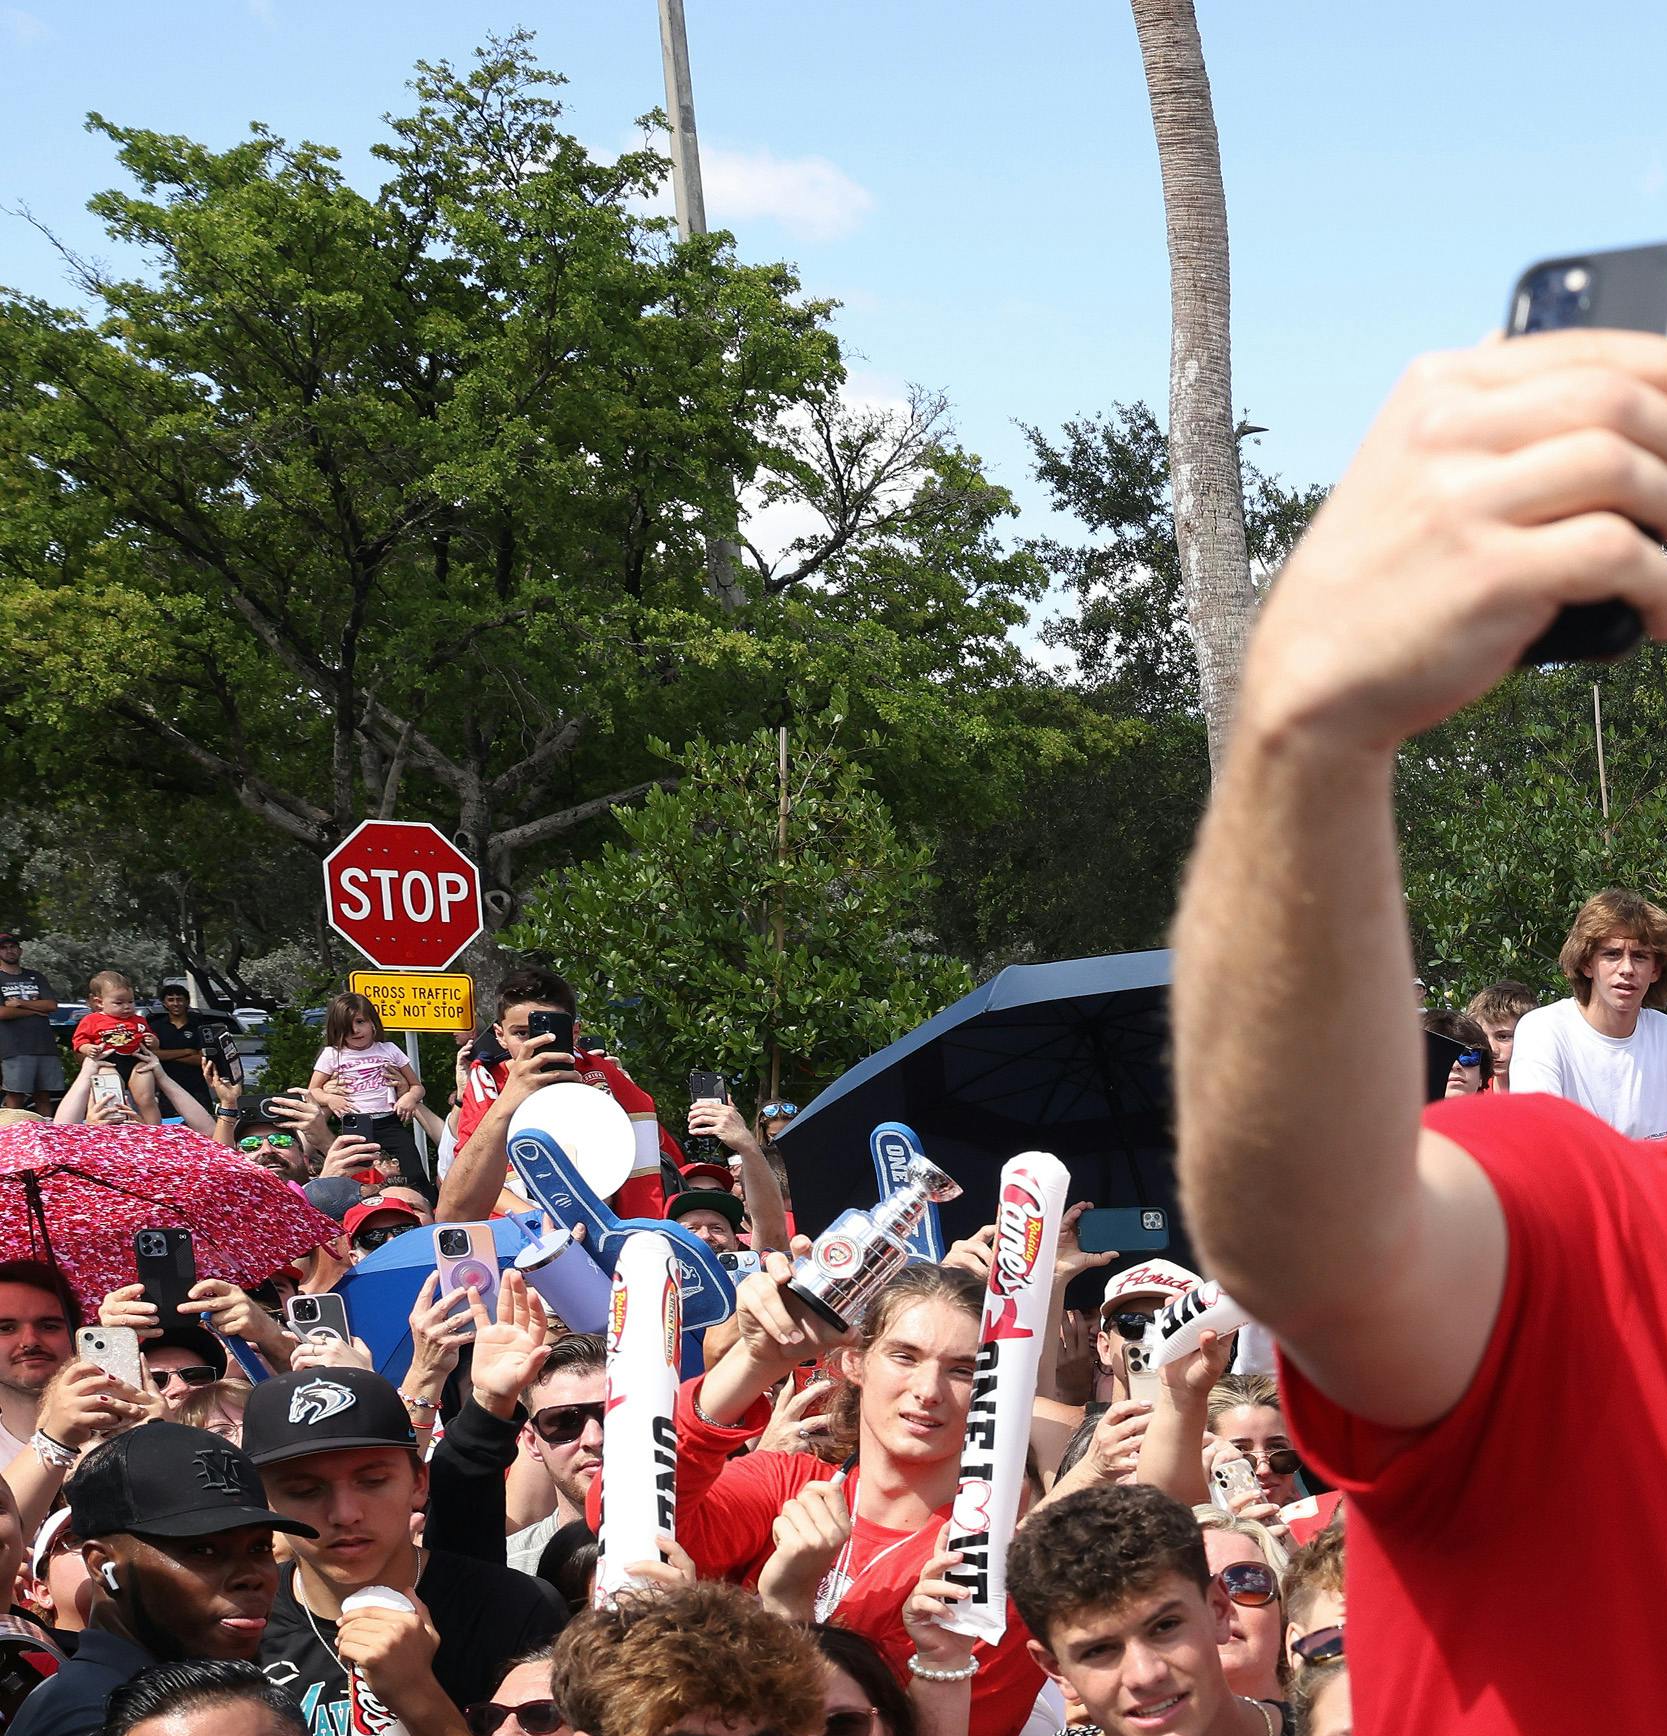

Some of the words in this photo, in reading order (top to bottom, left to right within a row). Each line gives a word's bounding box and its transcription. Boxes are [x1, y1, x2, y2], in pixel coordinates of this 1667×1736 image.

[340, 867, 469, 923] STOP
[364, 985, 405, 999] CROSS
[413, 987, 462, 1001] TRAFFIC
[373, 1003, 397, 1017] OES
[404, 1005, 426, 1018] NOT
[434, 1007, 464, 1019] STOP
[886, 1144, 910, 1184] ONE
[999, 1174, 1048, 1298] Cane's
[1025, 1219, 1042, 1262] Raising
[613, 1289, 627, 1335] Raising
[668, 1290, 678, 1328] CHICKEN
[665, 1329, 675, 1360] FINGERS
